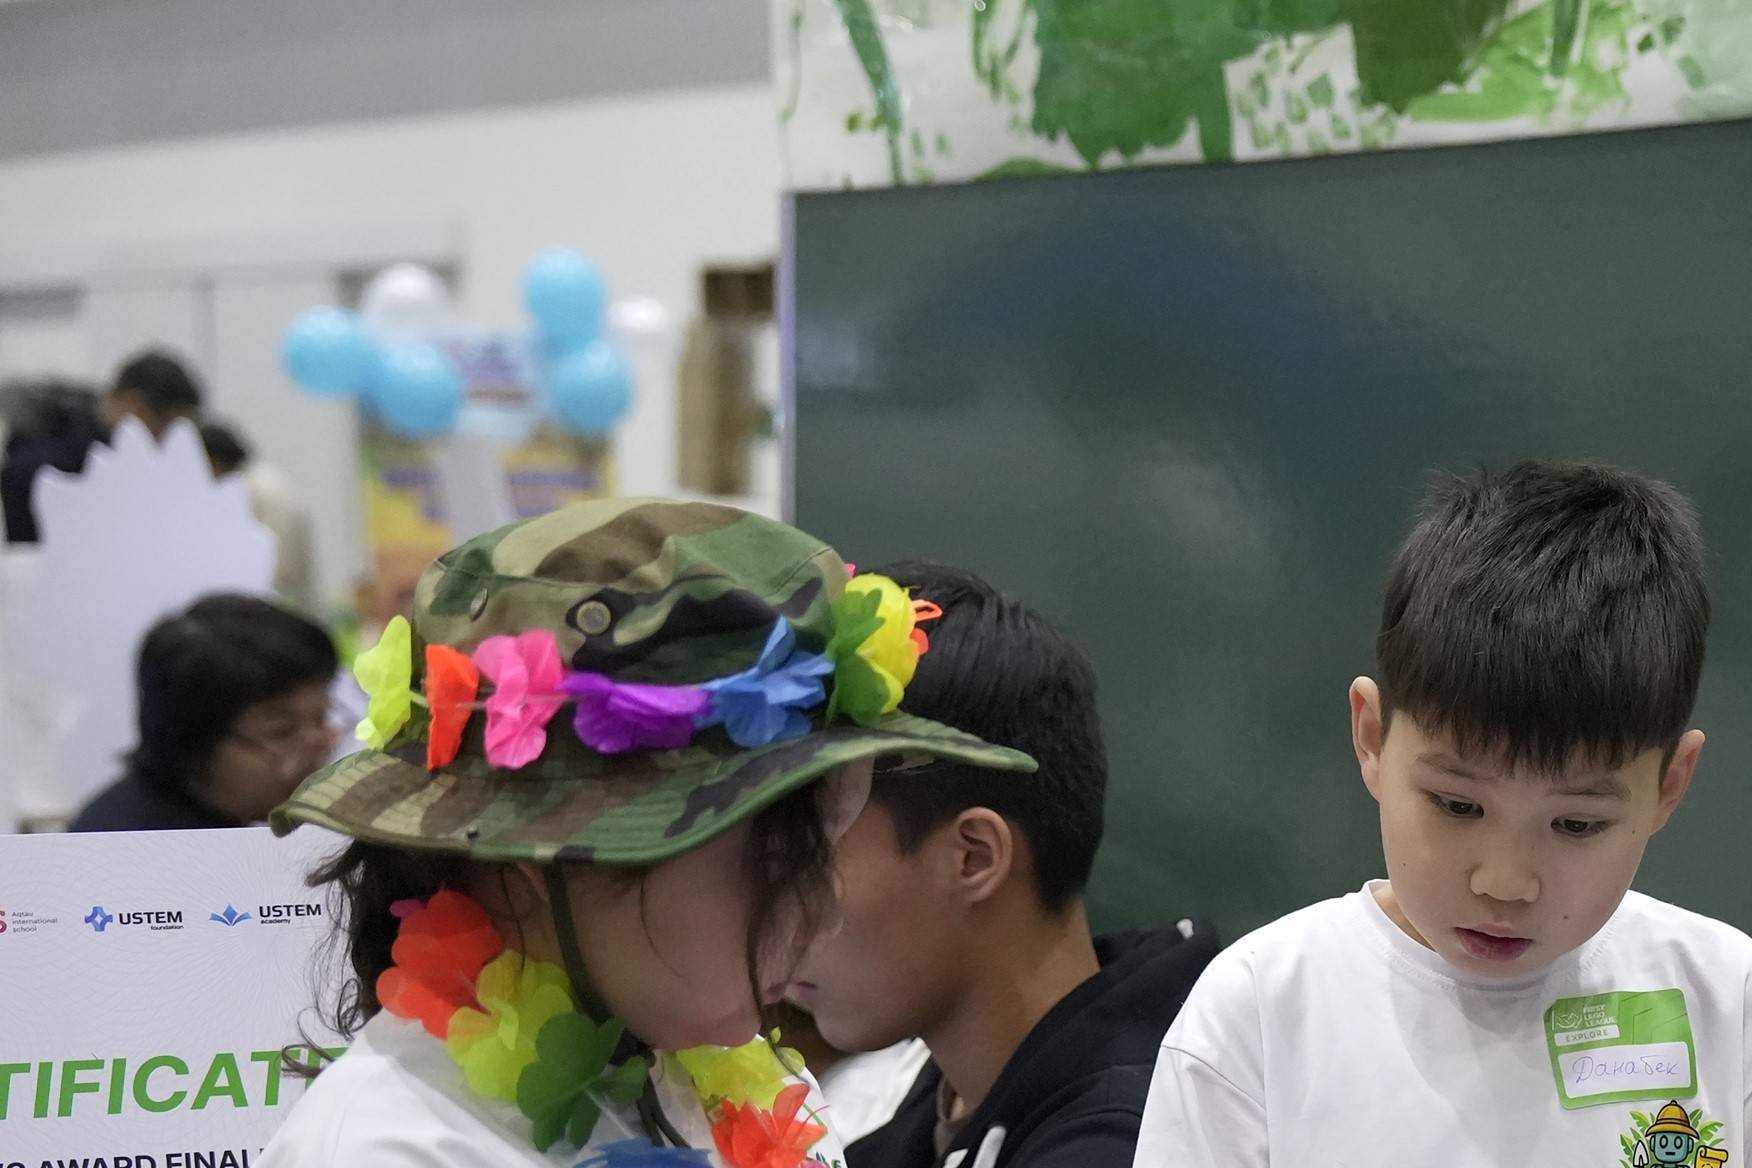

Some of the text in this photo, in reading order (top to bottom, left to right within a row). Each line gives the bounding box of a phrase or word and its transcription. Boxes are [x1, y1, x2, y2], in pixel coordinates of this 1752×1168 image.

[119, 911, 183, 925] USTEM
[258, 904, 321, 918] USTEM
[1566, 1028, 1609, 1042] EXPLORE
